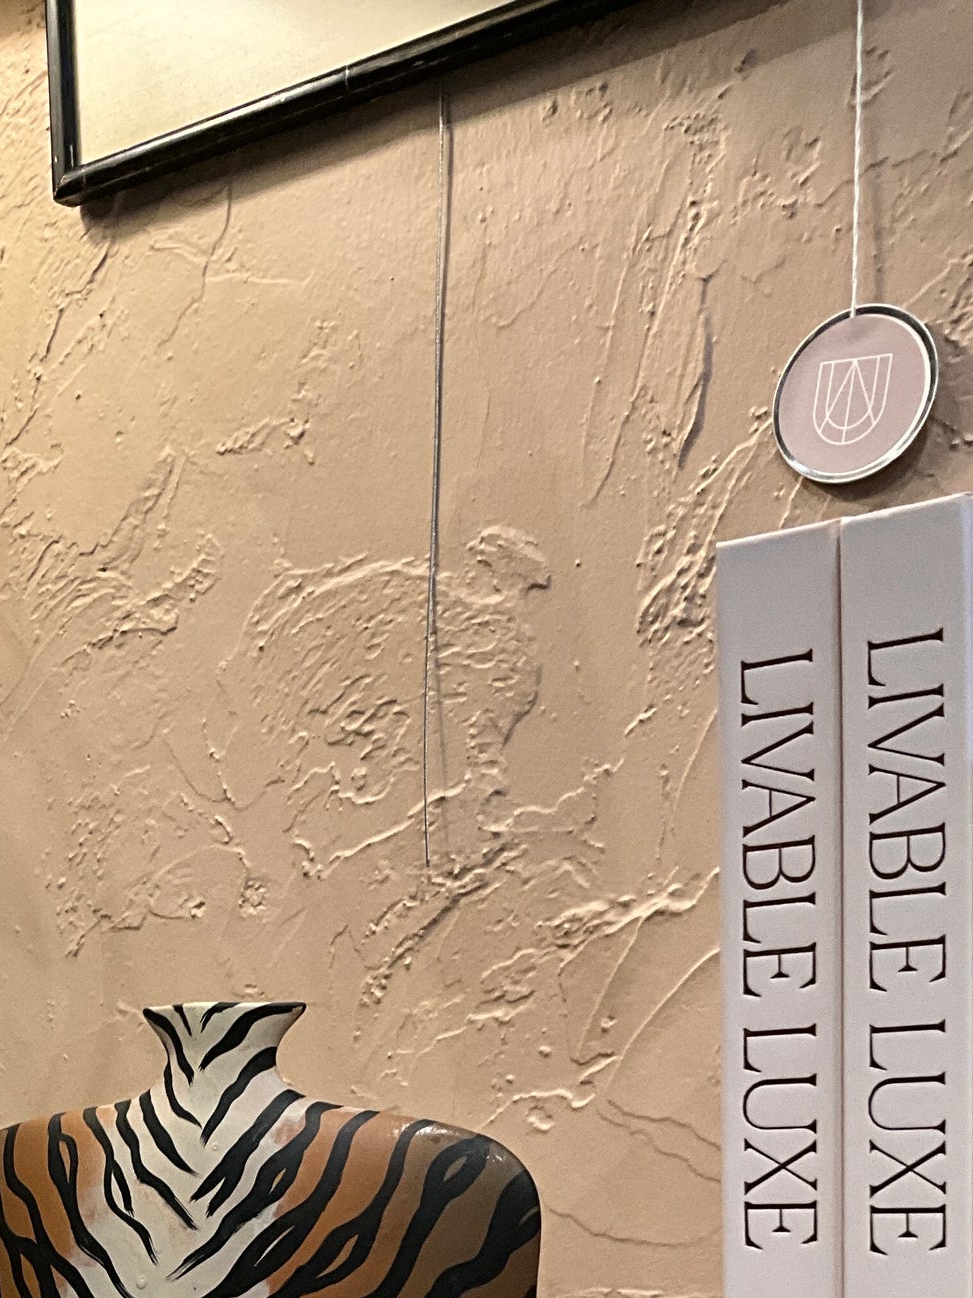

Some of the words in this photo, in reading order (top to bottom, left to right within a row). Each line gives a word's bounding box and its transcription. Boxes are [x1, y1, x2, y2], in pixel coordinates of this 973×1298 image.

[739, 647, 818, 998] LIVABLE
[867, 626, 947, 993] LIVABLE
[742, 1022, 819, 1251] LUXE
[867, 1018, 948, 1256] LUXE
